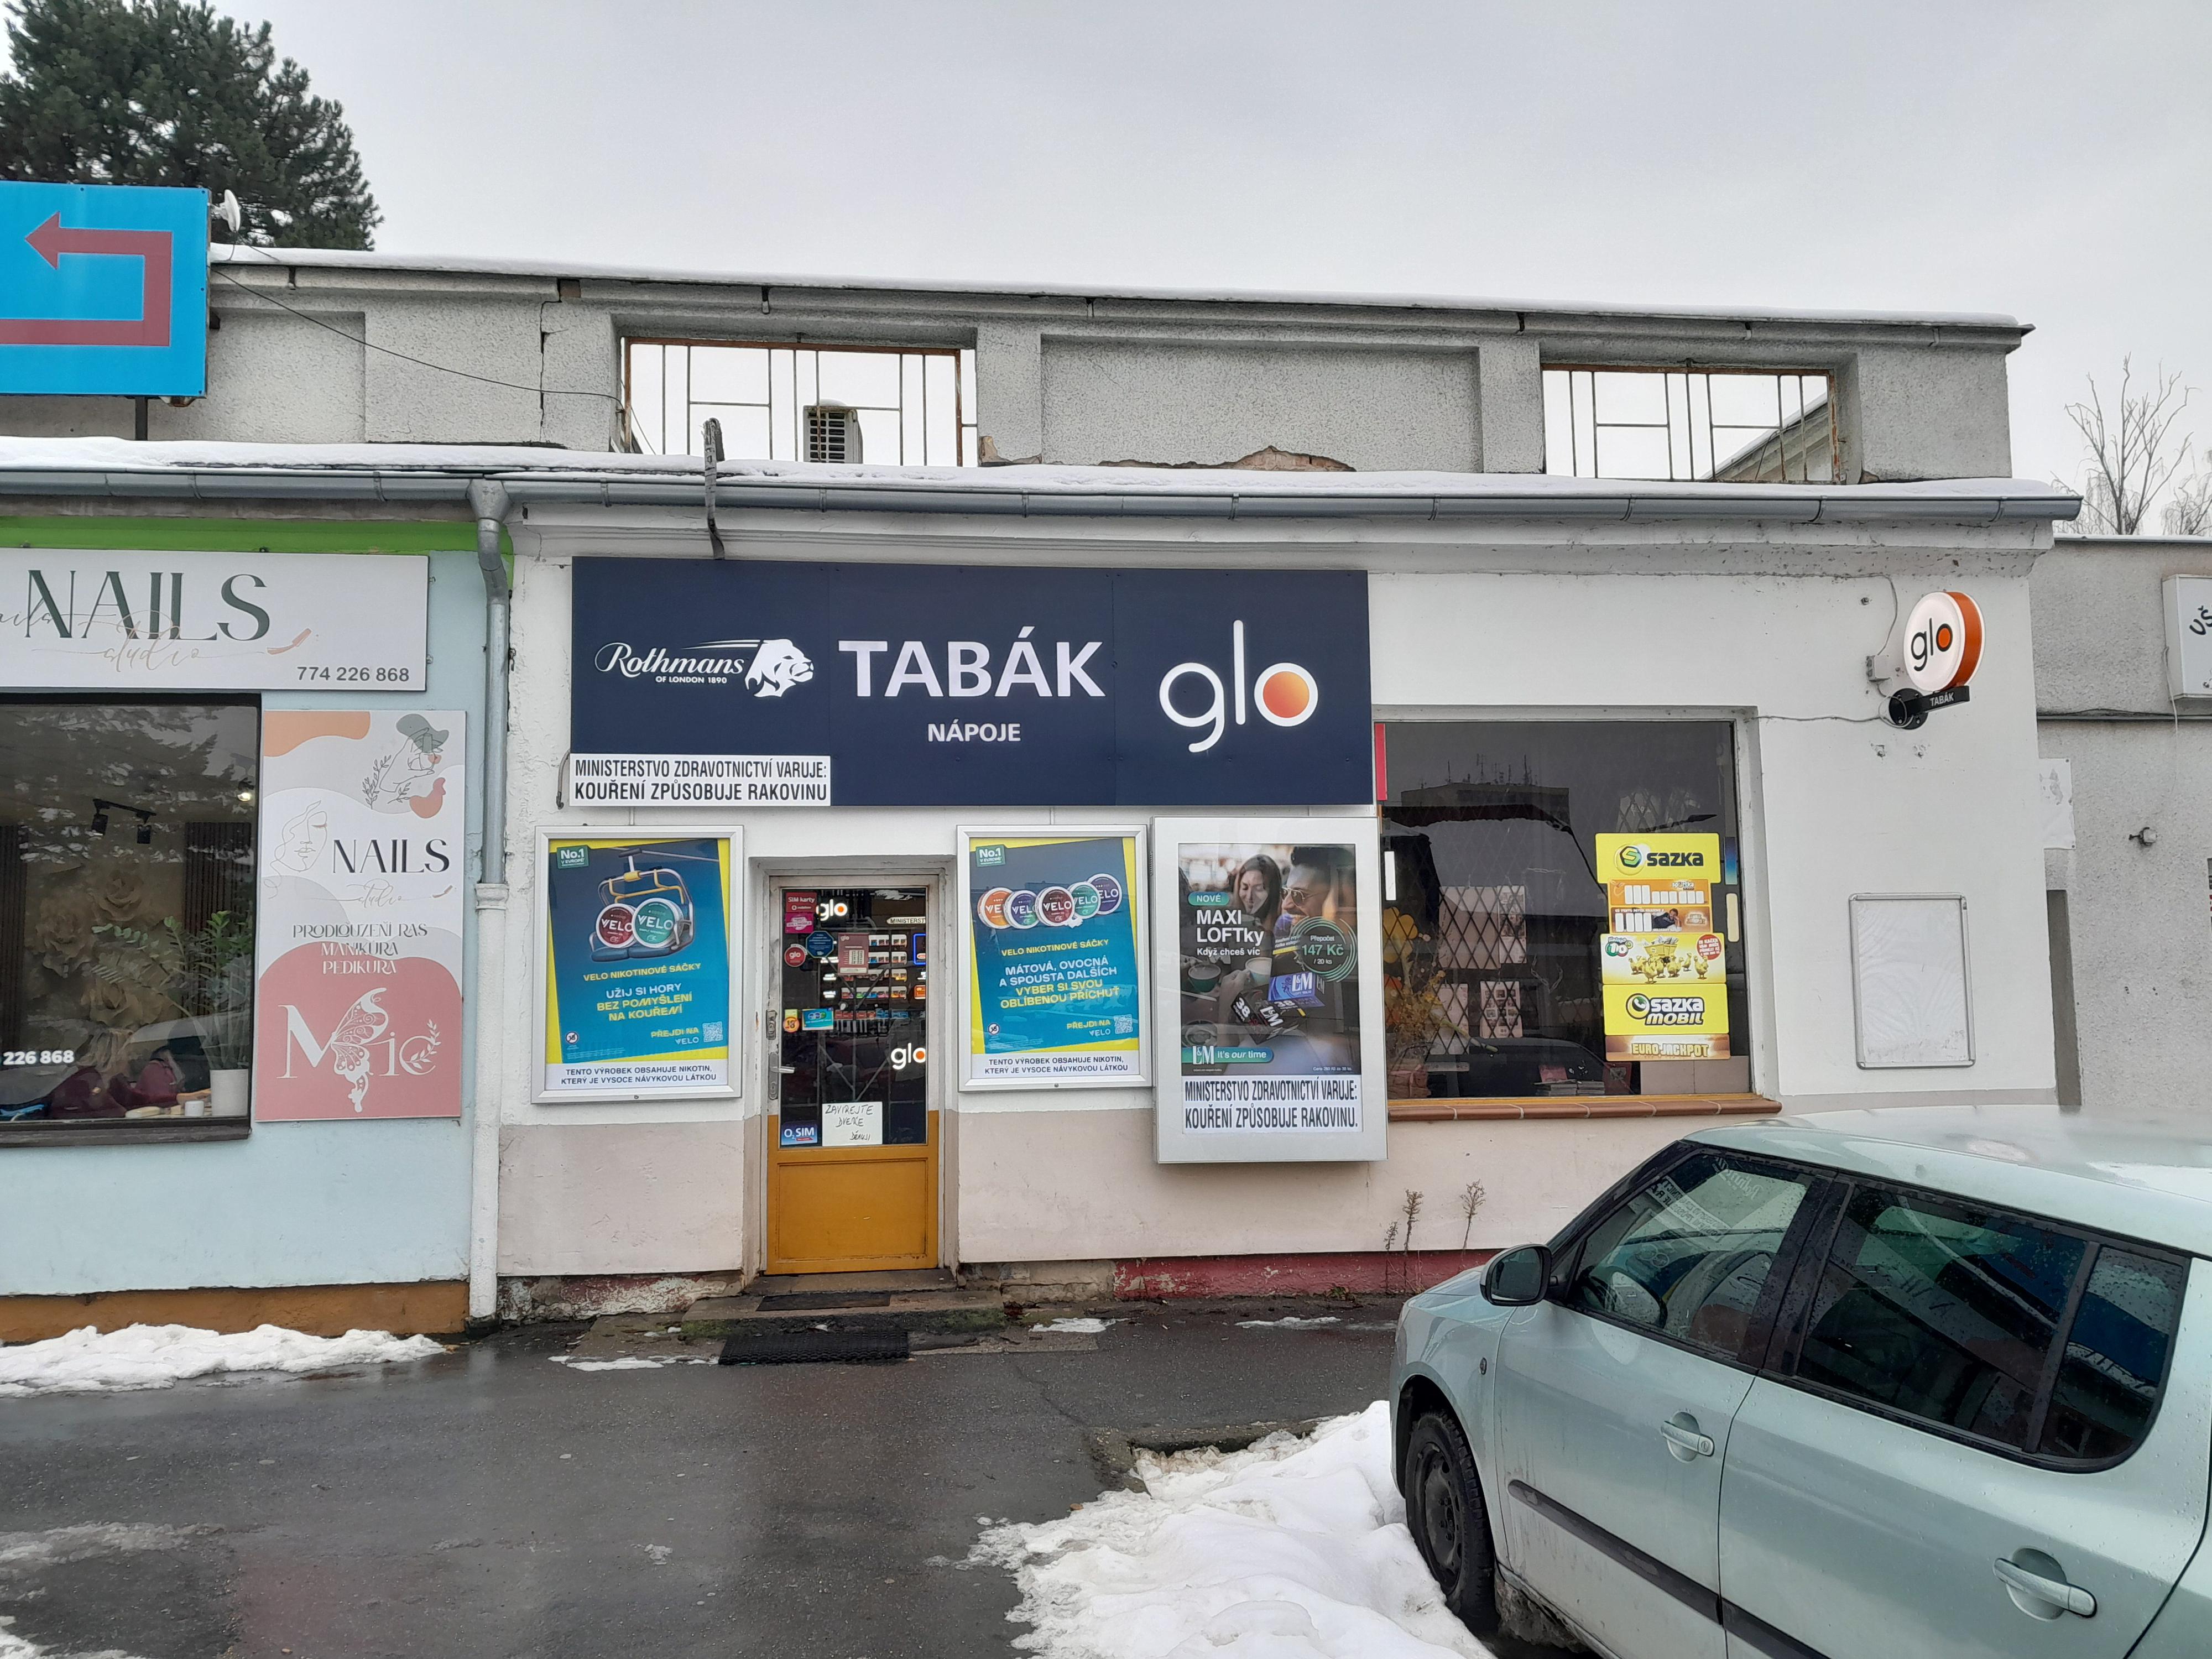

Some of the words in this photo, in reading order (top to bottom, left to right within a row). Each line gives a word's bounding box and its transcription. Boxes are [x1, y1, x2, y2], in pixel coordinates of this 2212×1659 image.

[25, 570, 270, 641] NAILS
[1911, 617, 1953, 671] glo
[595, 642, 744, 677] Rothmans
[838, 625, 1106, 697] TABÁK
[297, 666, 330, 681] 774
[336, 667, 370, 681] 226
[376, 667, 409, 682] 868
[1159, 619, 1319, 753] glo
[1929, 692, 1954, 707] TABÁK
[927, 719, 1021, 742] NÁPOJE
[575, 759, 670, 777] MINISTERSTVO
[674, 758, 774, 778] ZDRAVOTNICTVÍ
[776, 761, 827, 778] VARUJE:
[575, 779, 646, 800] KOUŘENÍ
[650, 779, 742, 800] ZPŮSOBUJE
[748, 783, 827, 800] RAKOVINU
[333, 839, 450, 873] NAILS
[560, 848, 585, 859] No.1
[979, 847, 1001, 858] No.1
[1099, 889, 1119, 899] ELO
[1196, 893, 1221, 902] NOVÉ
[816, 899, 848, 921] glo
[1043, 901, 1072, 911] VELO
[601, 919, 633, 932] VELO
[638, 915, 674, 930] VELO
[1197, 910, 1241, 925] MAXI
[1197, 927, 1265, 946] LOFTky
[1001, 948, 1024, 956] VELO
[1026, 941, 1077, 954] NIKOTINOVÉ
[1080, 938, 1109, 948] SÁČKY
[1197, 948, 1217, 957] Když
[1220, 947, 1245, 956] chceš
[1246, 947, 1260, 956] víc
[1302, 945, 1323, 956] 147
[1327, 943, 1344, 956] Kč
[583, 973, 608, 982] VELO
[611, 965, 667, 979] NIKOTINOVÉ
[669, 963, 701, 973] SÁČKY
[1005, 961, 1057, 975] MÁTOVÁ,
[1059, 955, 1109, 970] OVOCNÁ
[999, 978, 1007, 987] A
[1010, 972, 1065, 987] SPOUSTA
[1067, 966, 1117, 980] DALŠÍCH
[1292, 972, 1312, 992] L&M
[606, 987, 633, 999] UŽIJ
[635, 987, 646, 996] SI
[649, 983, 682, 994] HORY
[1016, 984, 1054, 996] VYBER
[1057, 982, 1068, 992] SI
[1071, 979, 1103, 990] SVOU
[597, 1001, 619, 1011] BEZ
[623, 992, 692, 1008] POMYŠLENÍ
[1000, 994, 1067, 1009] OBLÍBENOU
[1070, 986, 1120, 1001] PŘÍCHUŤ
[609, 1012, 625, 1021] NA
[628, 1004, 682, 1019] KOUŘENÍ
[1235, 997, 1250, 1018] 38
[1260, 1006, 1284, 1027] L&M
[1067, 1020, 1098, 1030] PŘEJDI
[3, 1051, 37, 1065] 226
[40, 1050, 75, 1064] 868
[891, 1042, 926, 1070] glo
[1192, 1046, 1214, 1065] L&M
[1248, 1050, 1267, 1058] time
[594, 1067, 632, 1075] VÝROBEK
[1185, 1080, 1249, 1102] MINISTERSTVO
[1252, 1076, 1319, 1101] ZDRAVOTNICTVÍ
[1321, 1080, 1358, 1100] VARUJE:
[1185, 1104, 1233, 1129] KOUŘENÍ
[1235, 1103, 1298, 1128] ZPŮSOBUJE
[1301, 1107, 1358, 1128] RAKOVINU.
[796, 1127, 814, 1137] SIM
